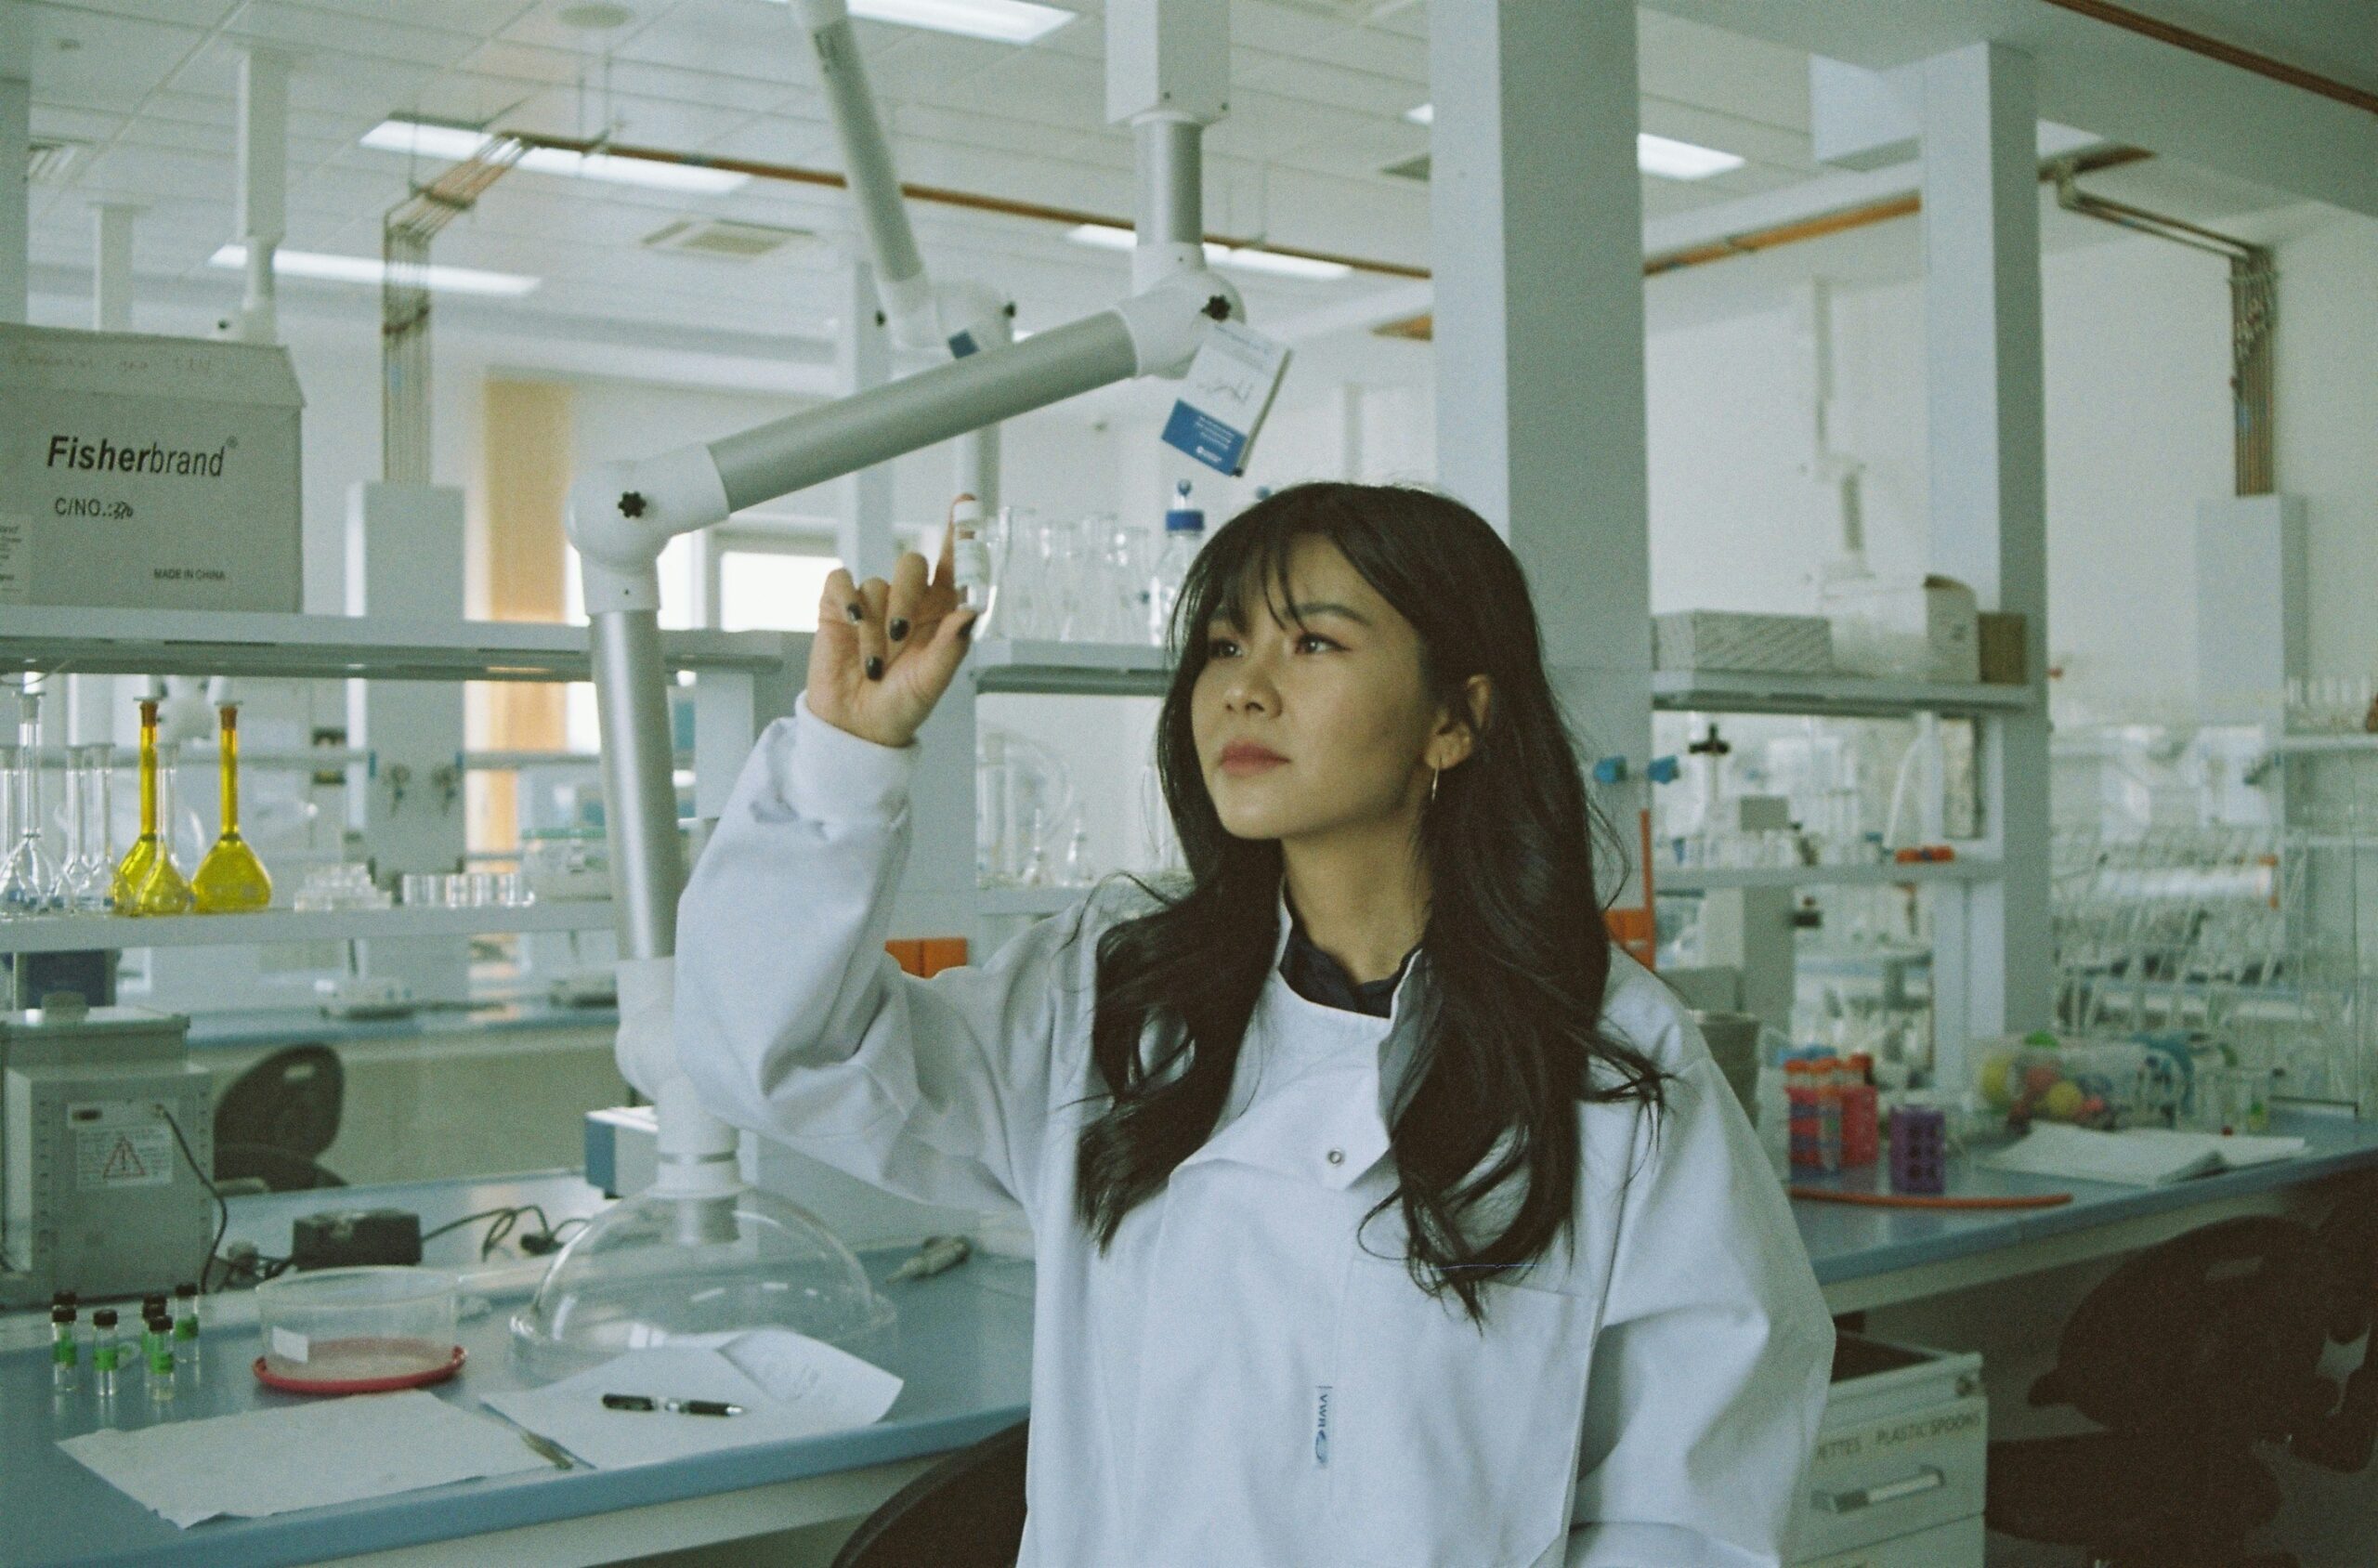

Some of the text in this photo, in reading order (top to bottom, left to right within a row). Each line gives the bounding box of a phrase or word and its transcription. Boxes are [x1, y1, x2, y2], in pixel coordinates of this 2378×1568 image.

[153, 568, 226, 581] MADE IN CHINA
